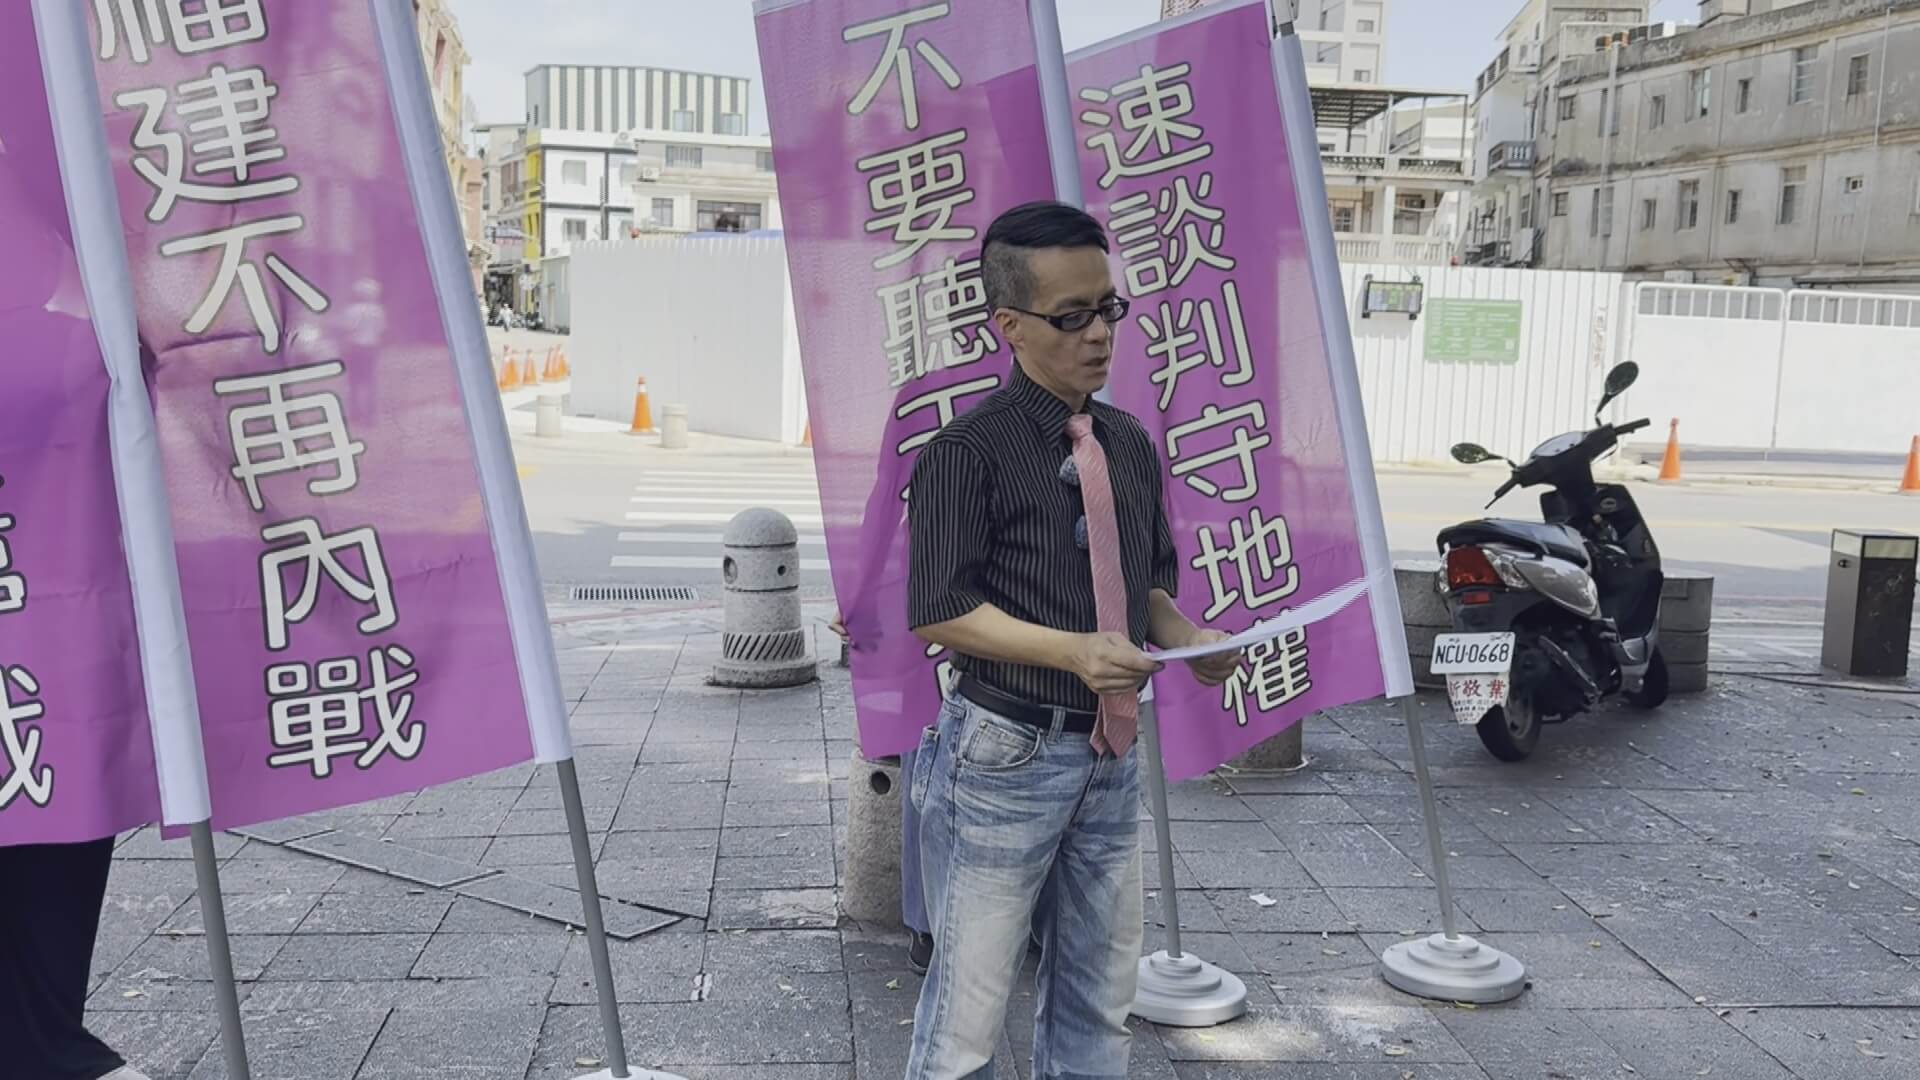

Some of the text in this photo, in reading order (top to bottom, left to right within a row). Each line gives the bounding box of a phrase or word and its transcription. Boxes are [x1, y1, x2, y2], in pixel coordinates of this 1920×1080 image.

[1079, 63, 1312, 726] 速談判守地權
